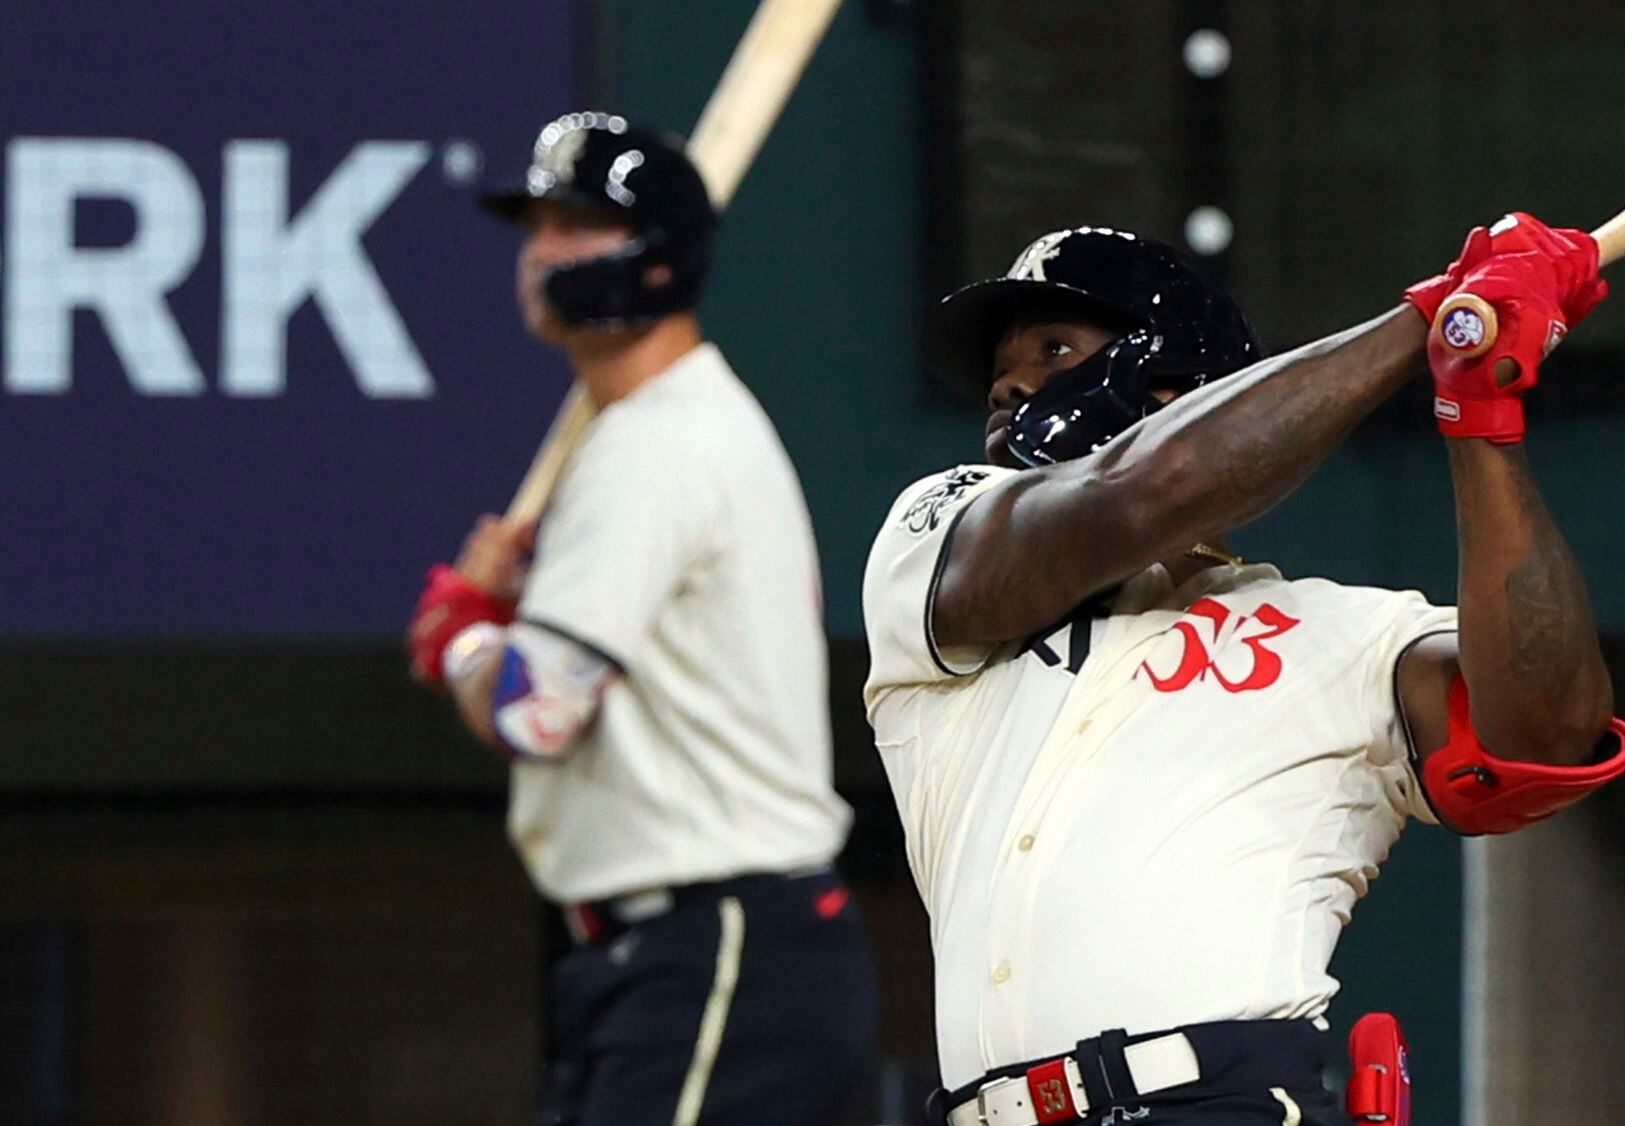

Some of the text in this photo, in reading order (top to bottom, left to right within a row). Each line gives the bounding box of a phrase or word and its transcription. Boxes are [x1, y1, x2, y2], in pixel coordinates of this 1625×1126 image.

[5, 136, 437, 398] RK
[1131, 596, 1301, 693] 53
[1036, 1078, 1067, 1114] 53
